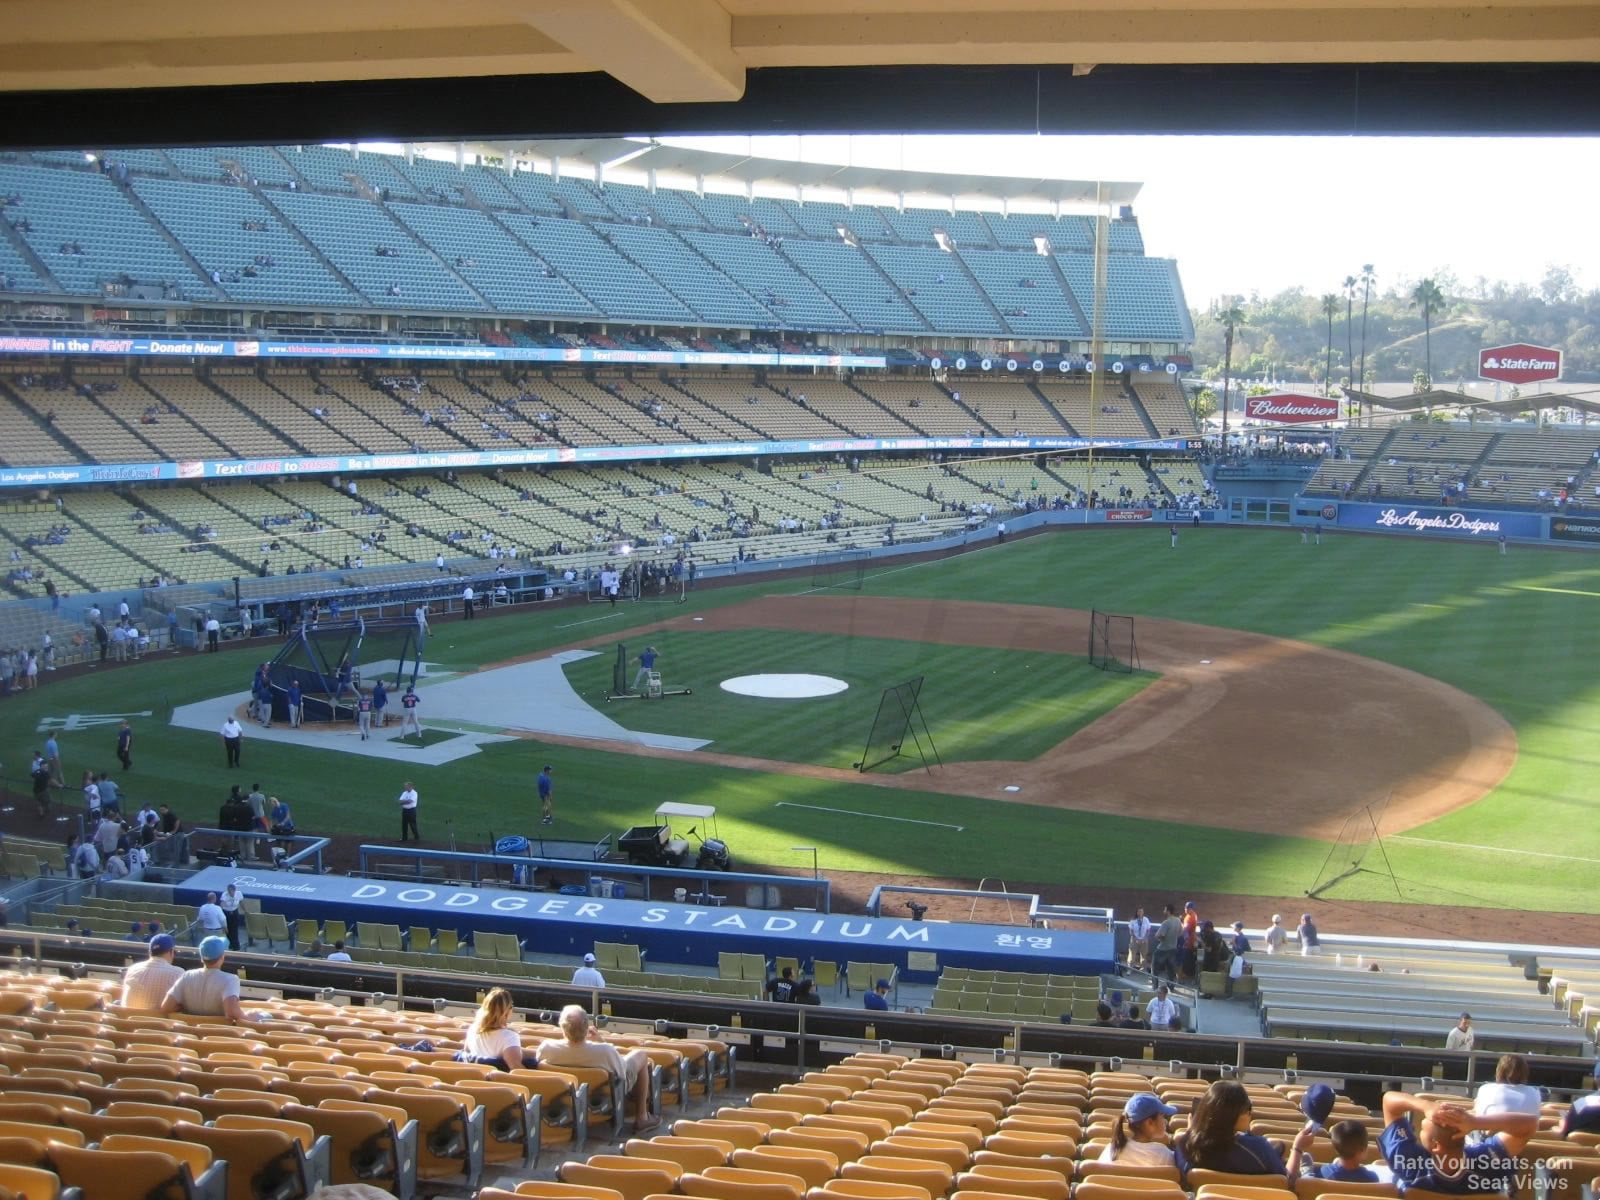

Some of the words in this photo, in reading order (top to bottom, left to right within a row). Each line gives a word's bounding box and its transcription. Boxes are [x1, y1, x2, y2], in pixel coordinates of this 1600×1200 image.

[53, 340, 65, 350] in
[68, 340, 89, 351] the
[150, 342, 193, 353] Donate
[195, 343, 223, 353] Now!
[592, 351, 611, 360] Text
[1249, 401, 1337, 416] Budweiser
[983, 439, 1009, 447] Donate
[349, 458, 362, 468] Be
[418, 456, 428, 465] in
[430, 456, 446, 465] the
[492, 453, 524, 462] Donate
[526, 452, 548, 461] Now!
[215, 463, 243, 474] Text
[284, 462, 298, 471] to
[17, 472, 46, 483] Angeles
[48, 470, 80, 481] Dodgers
[1376, 509, 1402, 527] Los
[1399, 511, 1448, 531] Angeles
[1447, 513, 1500, 535] Dodgers
[233, 876, 317, 893] Bienvenidos
[351, 885, 604, 918] DODGER
[641, 908, 929, 942] STADIUM
[994, 934, 1053, 949] 환영
